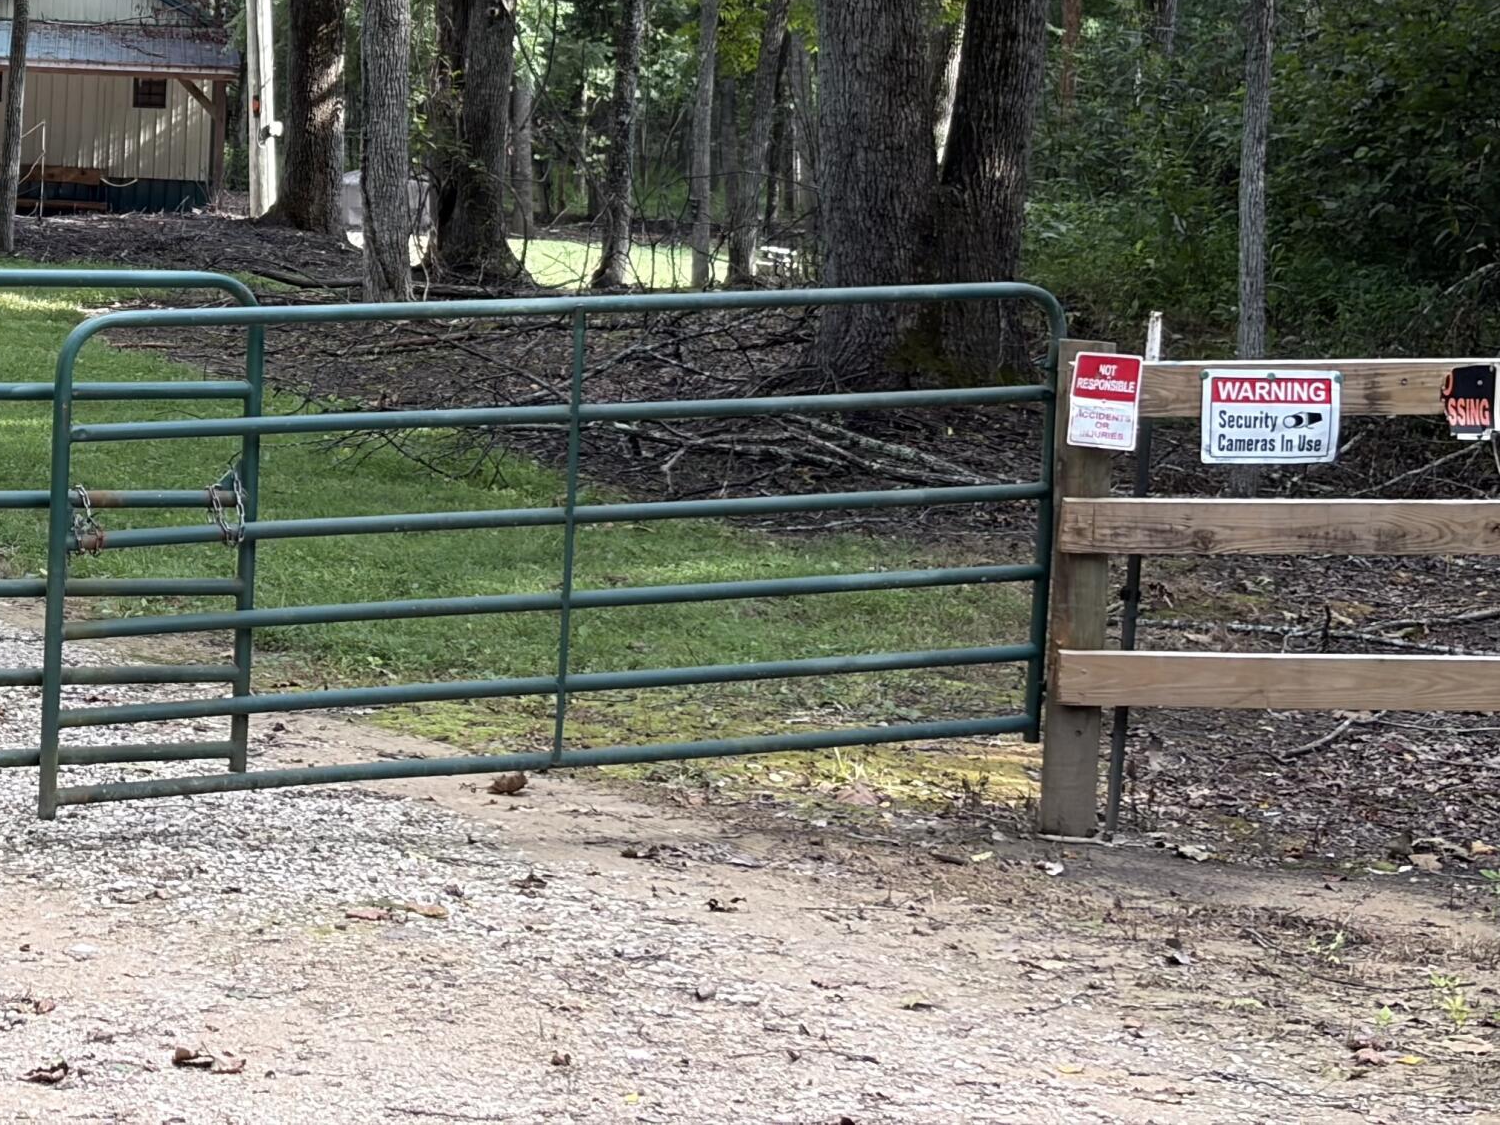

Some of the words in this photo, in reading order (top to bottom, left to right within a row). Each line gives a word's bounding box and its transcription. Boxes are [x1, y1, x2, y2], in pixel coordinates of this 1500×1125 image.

[1099, 364, 1118, 376] NOT
[1076, 377, 1136, 393] RESPONSIBLE
[1217, 381, 1327, 402] WARNING
[1444, 397, 1490, 426] SSING
[1094, 421, 1110, 430] OR
[1218, 410, 1278, 432] Security
[1217, 434, 1276, 452] Cameras
[1280, 435, 1293, 452] In
[1298, 435, 1322, 452] Use
